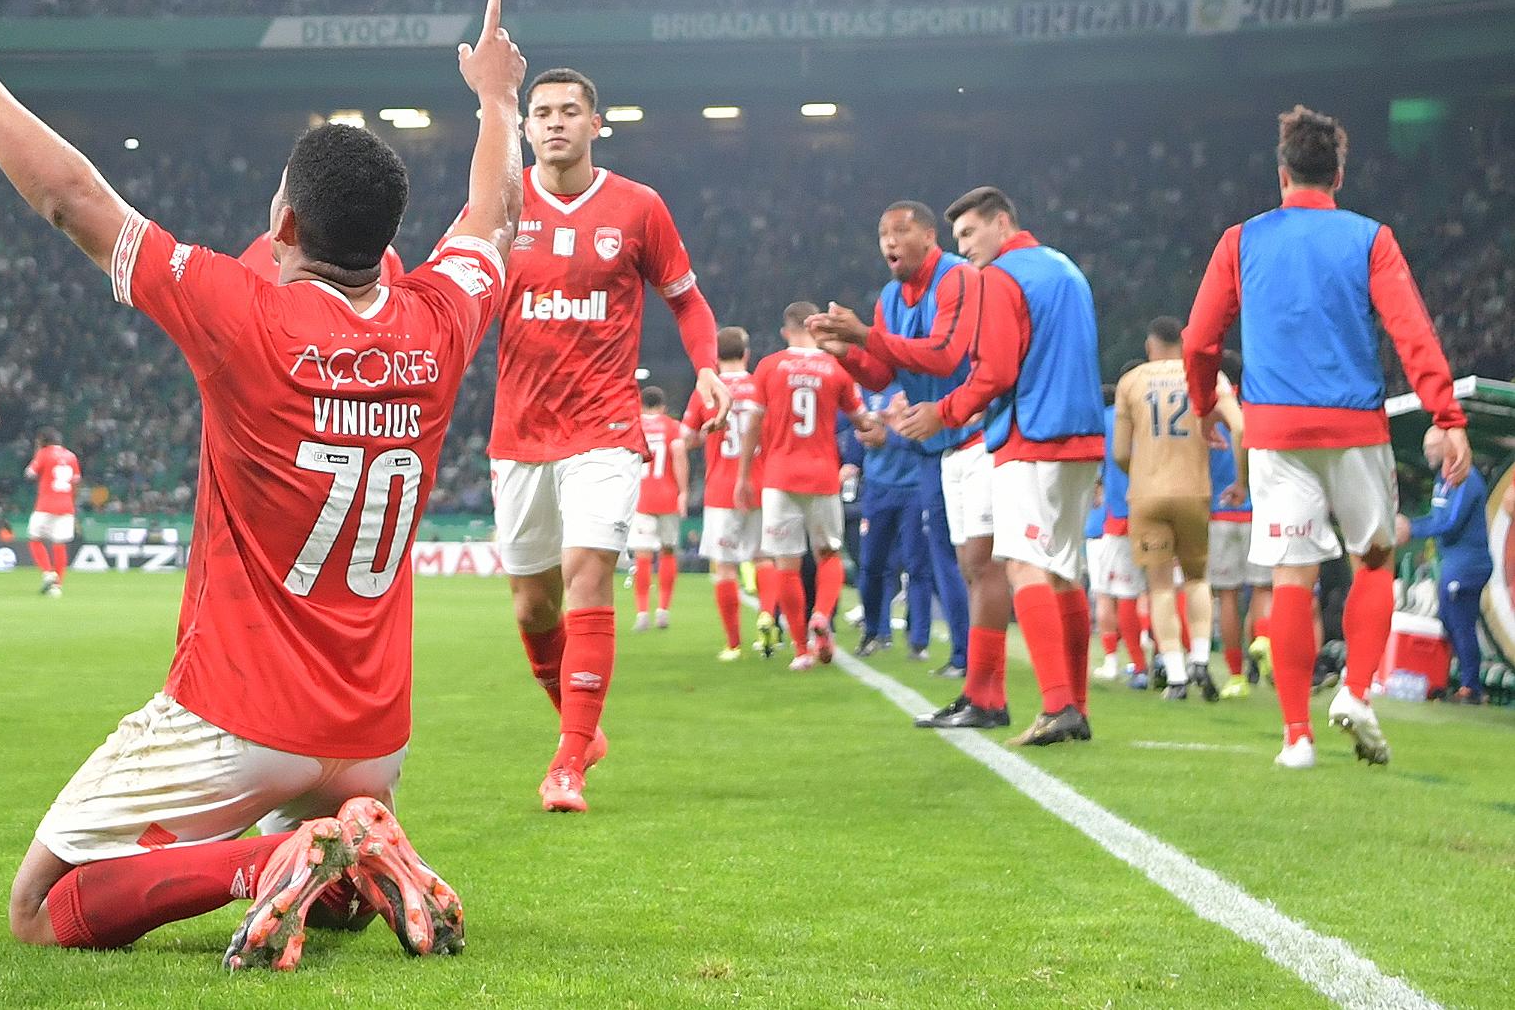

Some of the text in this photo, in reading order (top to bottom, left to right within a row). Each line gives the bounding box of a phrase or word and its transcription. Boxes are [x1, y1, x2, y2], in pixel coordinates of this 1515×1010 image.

[652, 12, 775, 40] BRIGADA
[780, 9, 885, 38] ULTRAS
[521, 290, 607, 321] Lebull
[290, 344, 439, 390] AÇORES
[313, 396, 422, 438] VINICIUS
[792, 387, 817, 438] 9
[1145, 390, 1190, 438] 12
[283, 440, 423, 599] 70
